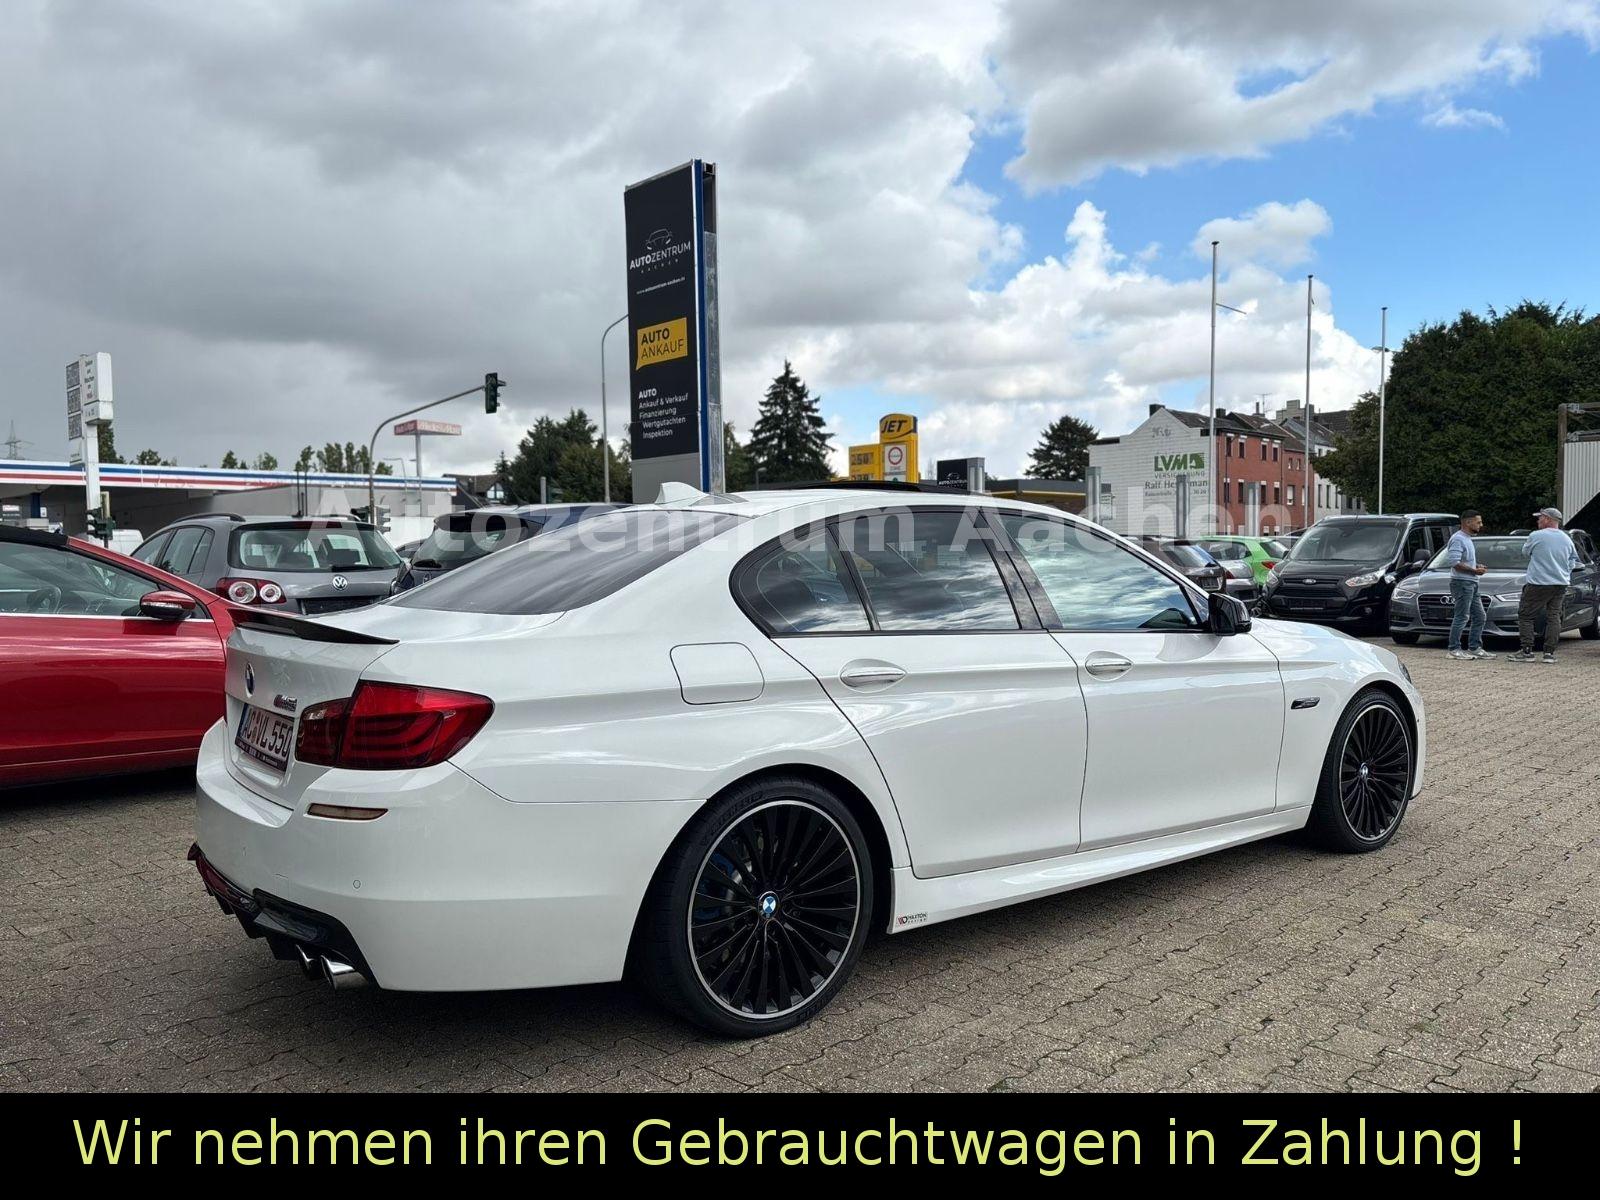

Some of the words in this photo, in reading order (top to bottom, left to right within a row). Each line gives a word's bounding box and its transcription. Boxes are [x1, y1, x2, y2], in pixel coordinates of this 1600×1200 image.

[630, 241, 691, 269] AUTOZENTRUM
[641, 328, 670, 344] AUTO
[641, 338, 685, 360] ANKAUF
[638, 388, 657, 399] AUTO
[639, 397, 660, 409] Ankauf
[660, 397, 665, 406] &
[665, 392, 689, 404] Verkauf
[639, 407, 677, 419] Finanzierung
[642, 416, 687, 429] Wertgutachten
[881, 419, 908, 434] JET
[643, 428, 673, 439] Inspektion
[1154, 454, 1187, 471] LVM
[1145, 480, 1161, 489] Ralf
[268, 720, 293, 757] 550
